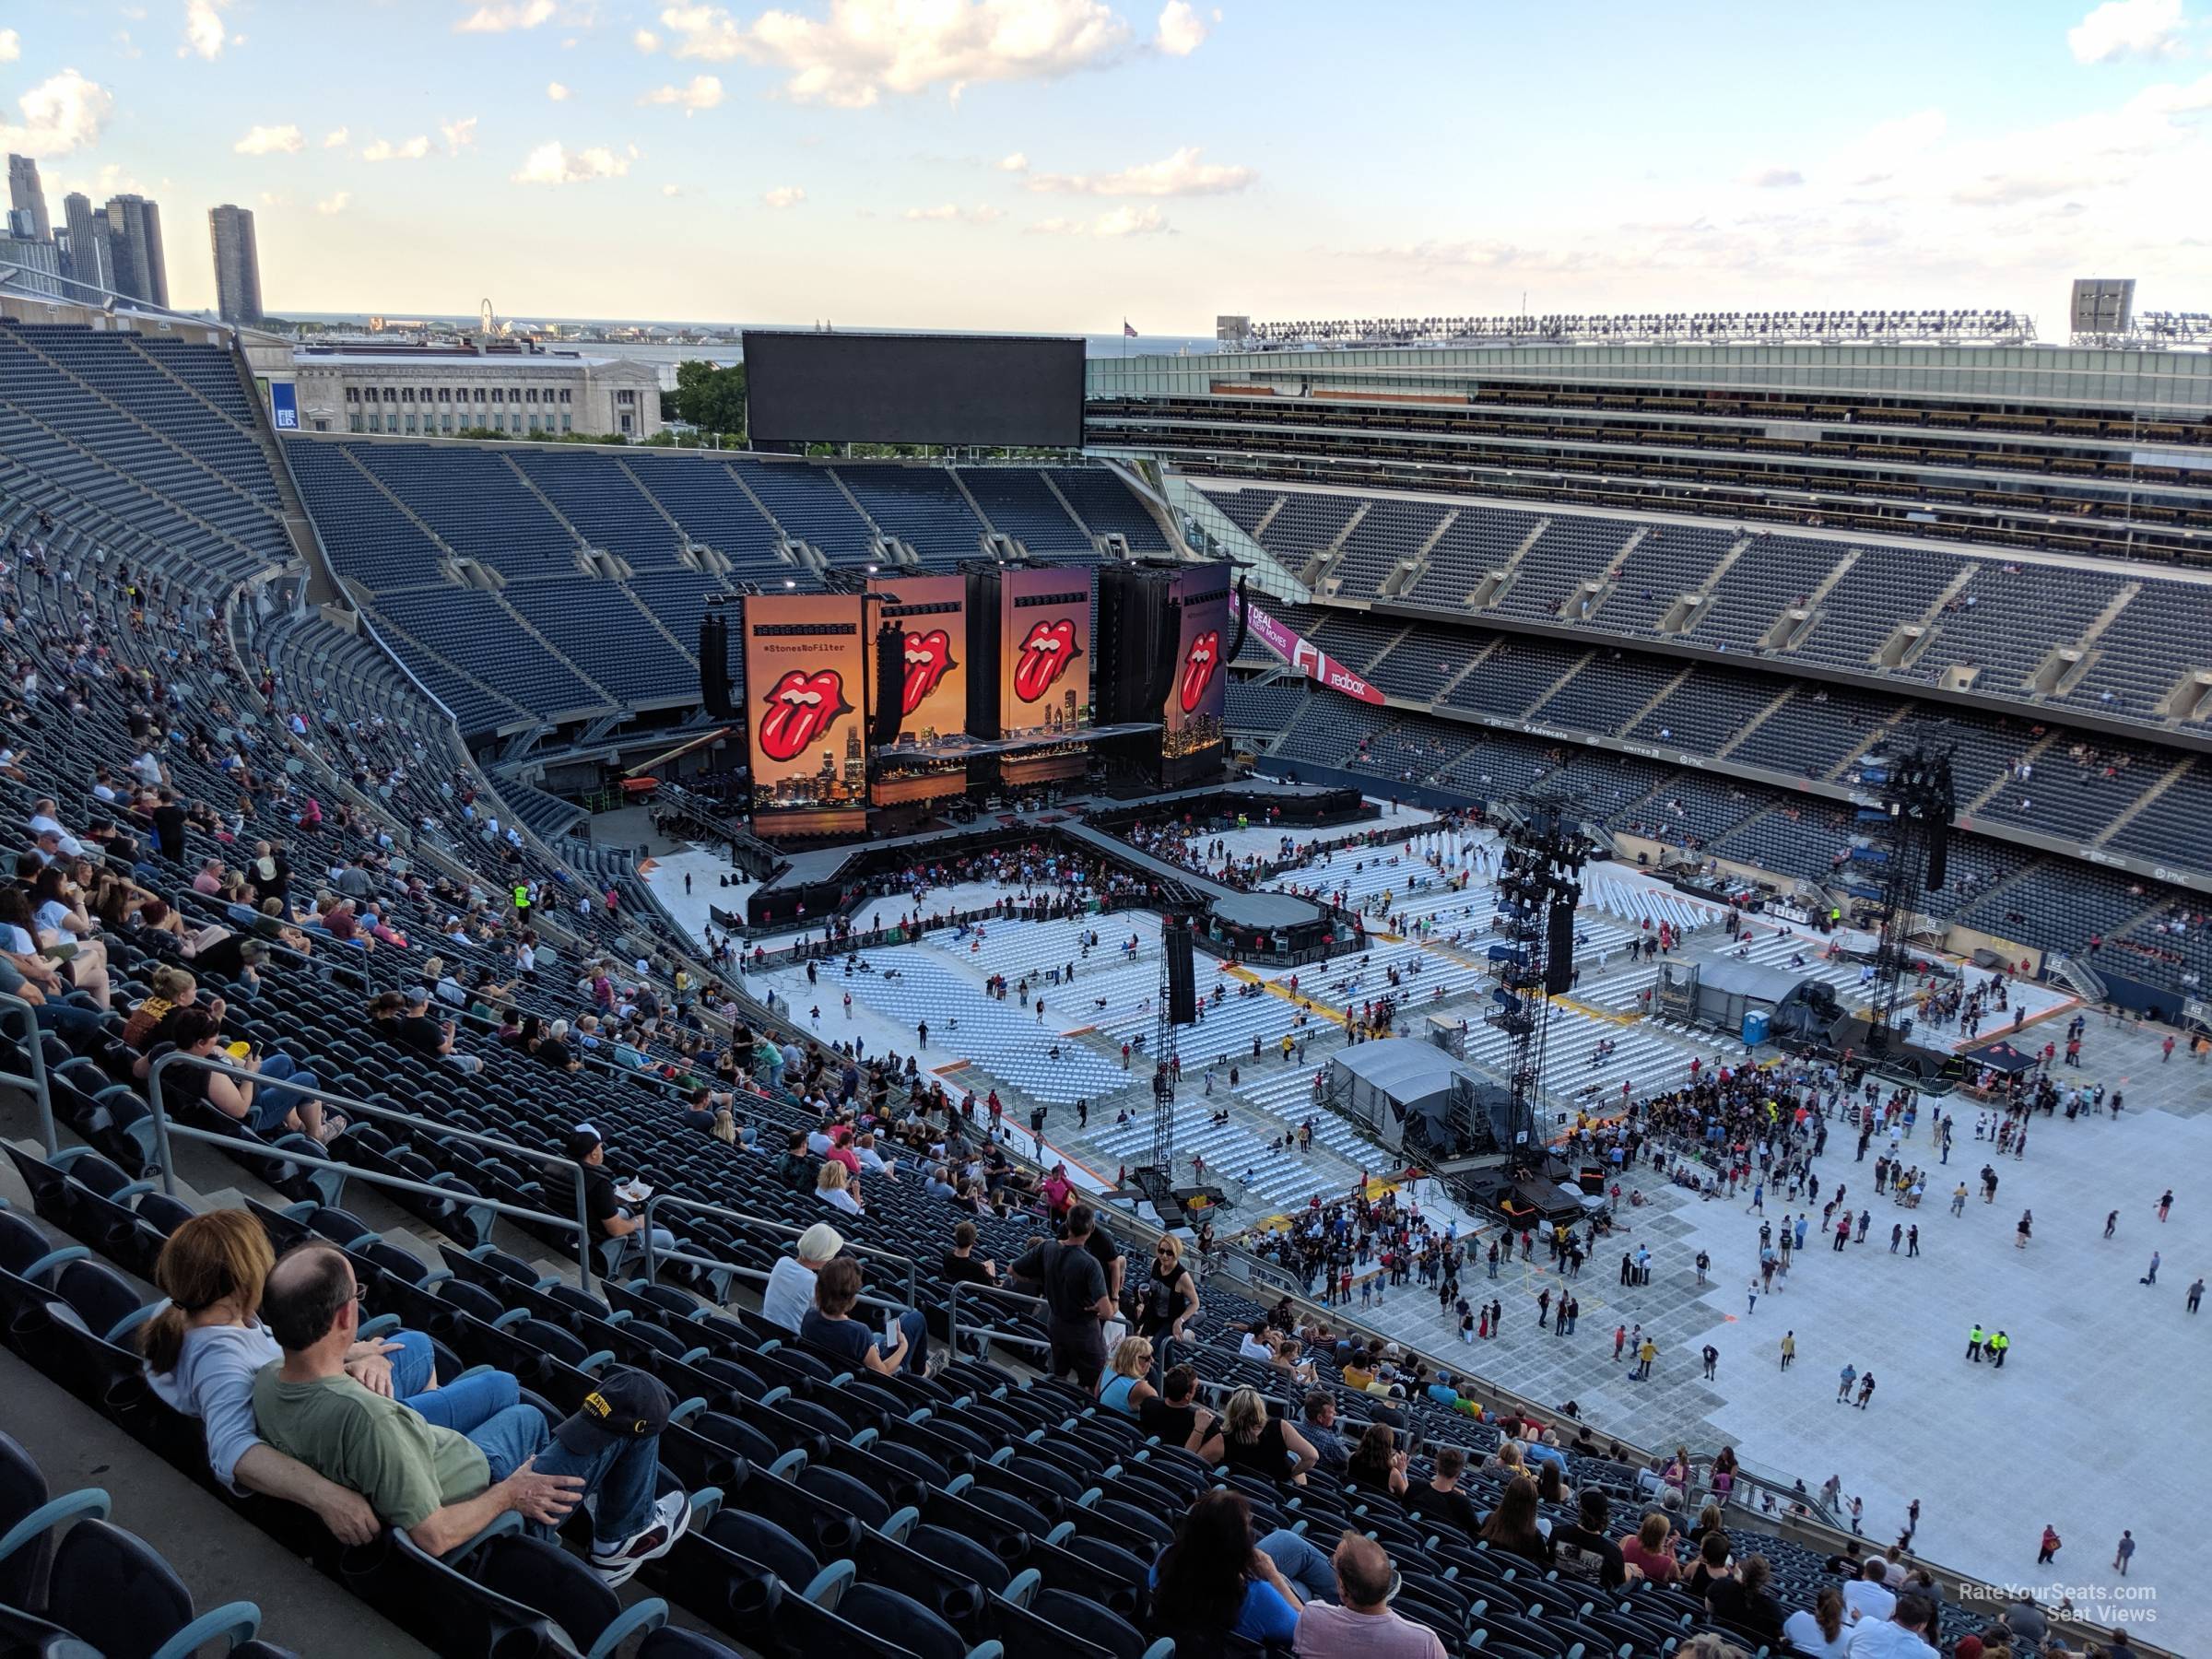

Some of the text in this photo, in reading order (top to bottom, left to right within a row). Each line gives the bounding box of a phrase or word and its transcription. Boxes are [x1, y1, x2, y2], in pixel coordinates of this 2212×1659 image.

[1253, 608, 1272, 629] DEAL
[1253, 618, 1266, 633] NEW
[1265, 627, 1287, 648] MOVIES
[763, 643, 845, 653] #StonesNoFilter
[1331, 673, 1366, 696] redbox
[1531, 725, 1569, 739] Advocate
[1623, 745, 1652, 755] UNITED
[1688, 757, 1705, 767] PNC
[2167, 871, 2190, 885] PNC
[634, 1419, 647, 1433] C
